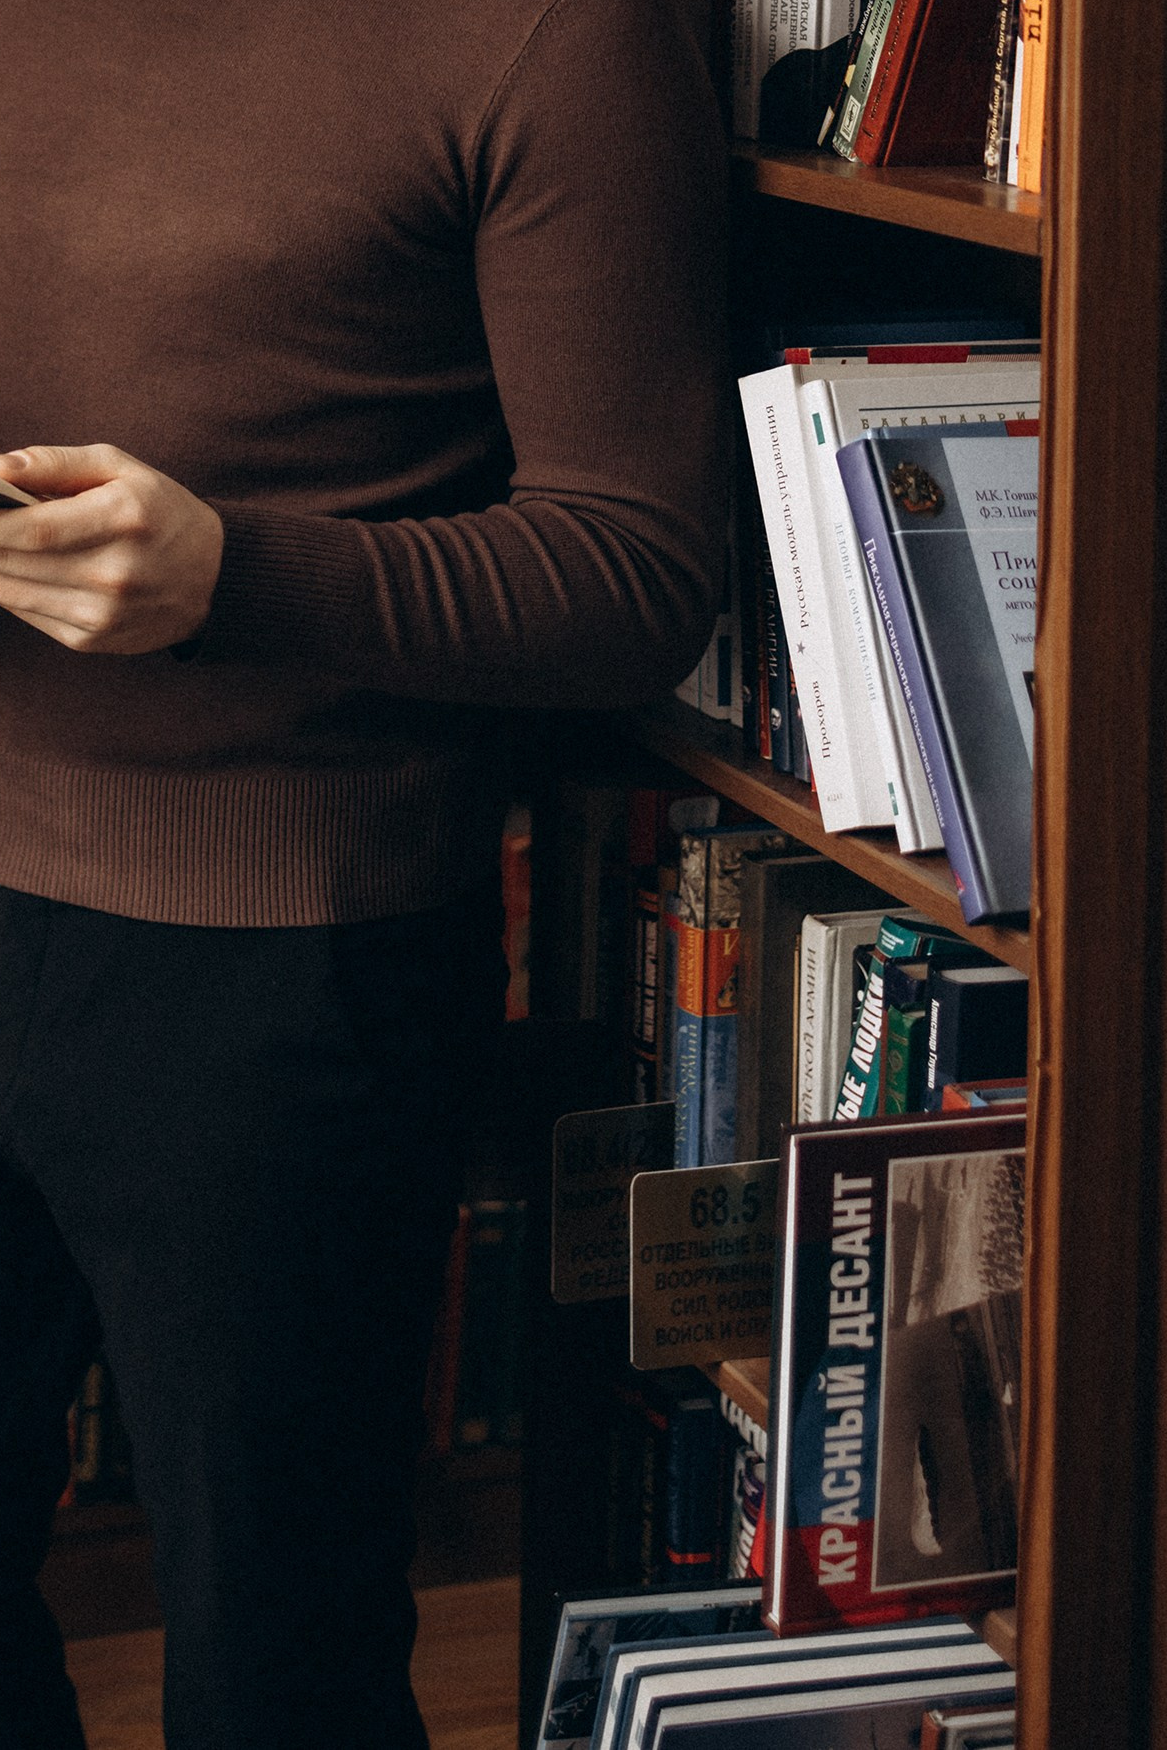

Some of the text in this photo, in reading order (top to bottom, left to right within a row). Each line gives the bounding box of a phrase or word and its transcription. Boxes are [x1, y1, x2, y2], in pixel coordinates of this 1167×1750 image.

[765, 404, 810, 629] Русская модель управления
[812, 680, 832, 759] Прохоров
[806, 946, 817, 1027] АРМИИ
[835, 972, 883, 1120] ЫЕ ЛОДКИ
[927, 998, 940, 1090] Александр Глушко
[690, 1181, 762, 1229] 68.5
[640, 1235, 750, 1264] ОТДЕЛЬНЫЕ
[655, 1319, 715, 1347] ВОЙСК
[720, 1320, 732, 1339] И
[817, 1172, 876, 1586] КРАСНЫЙ ДЕСАНТ
